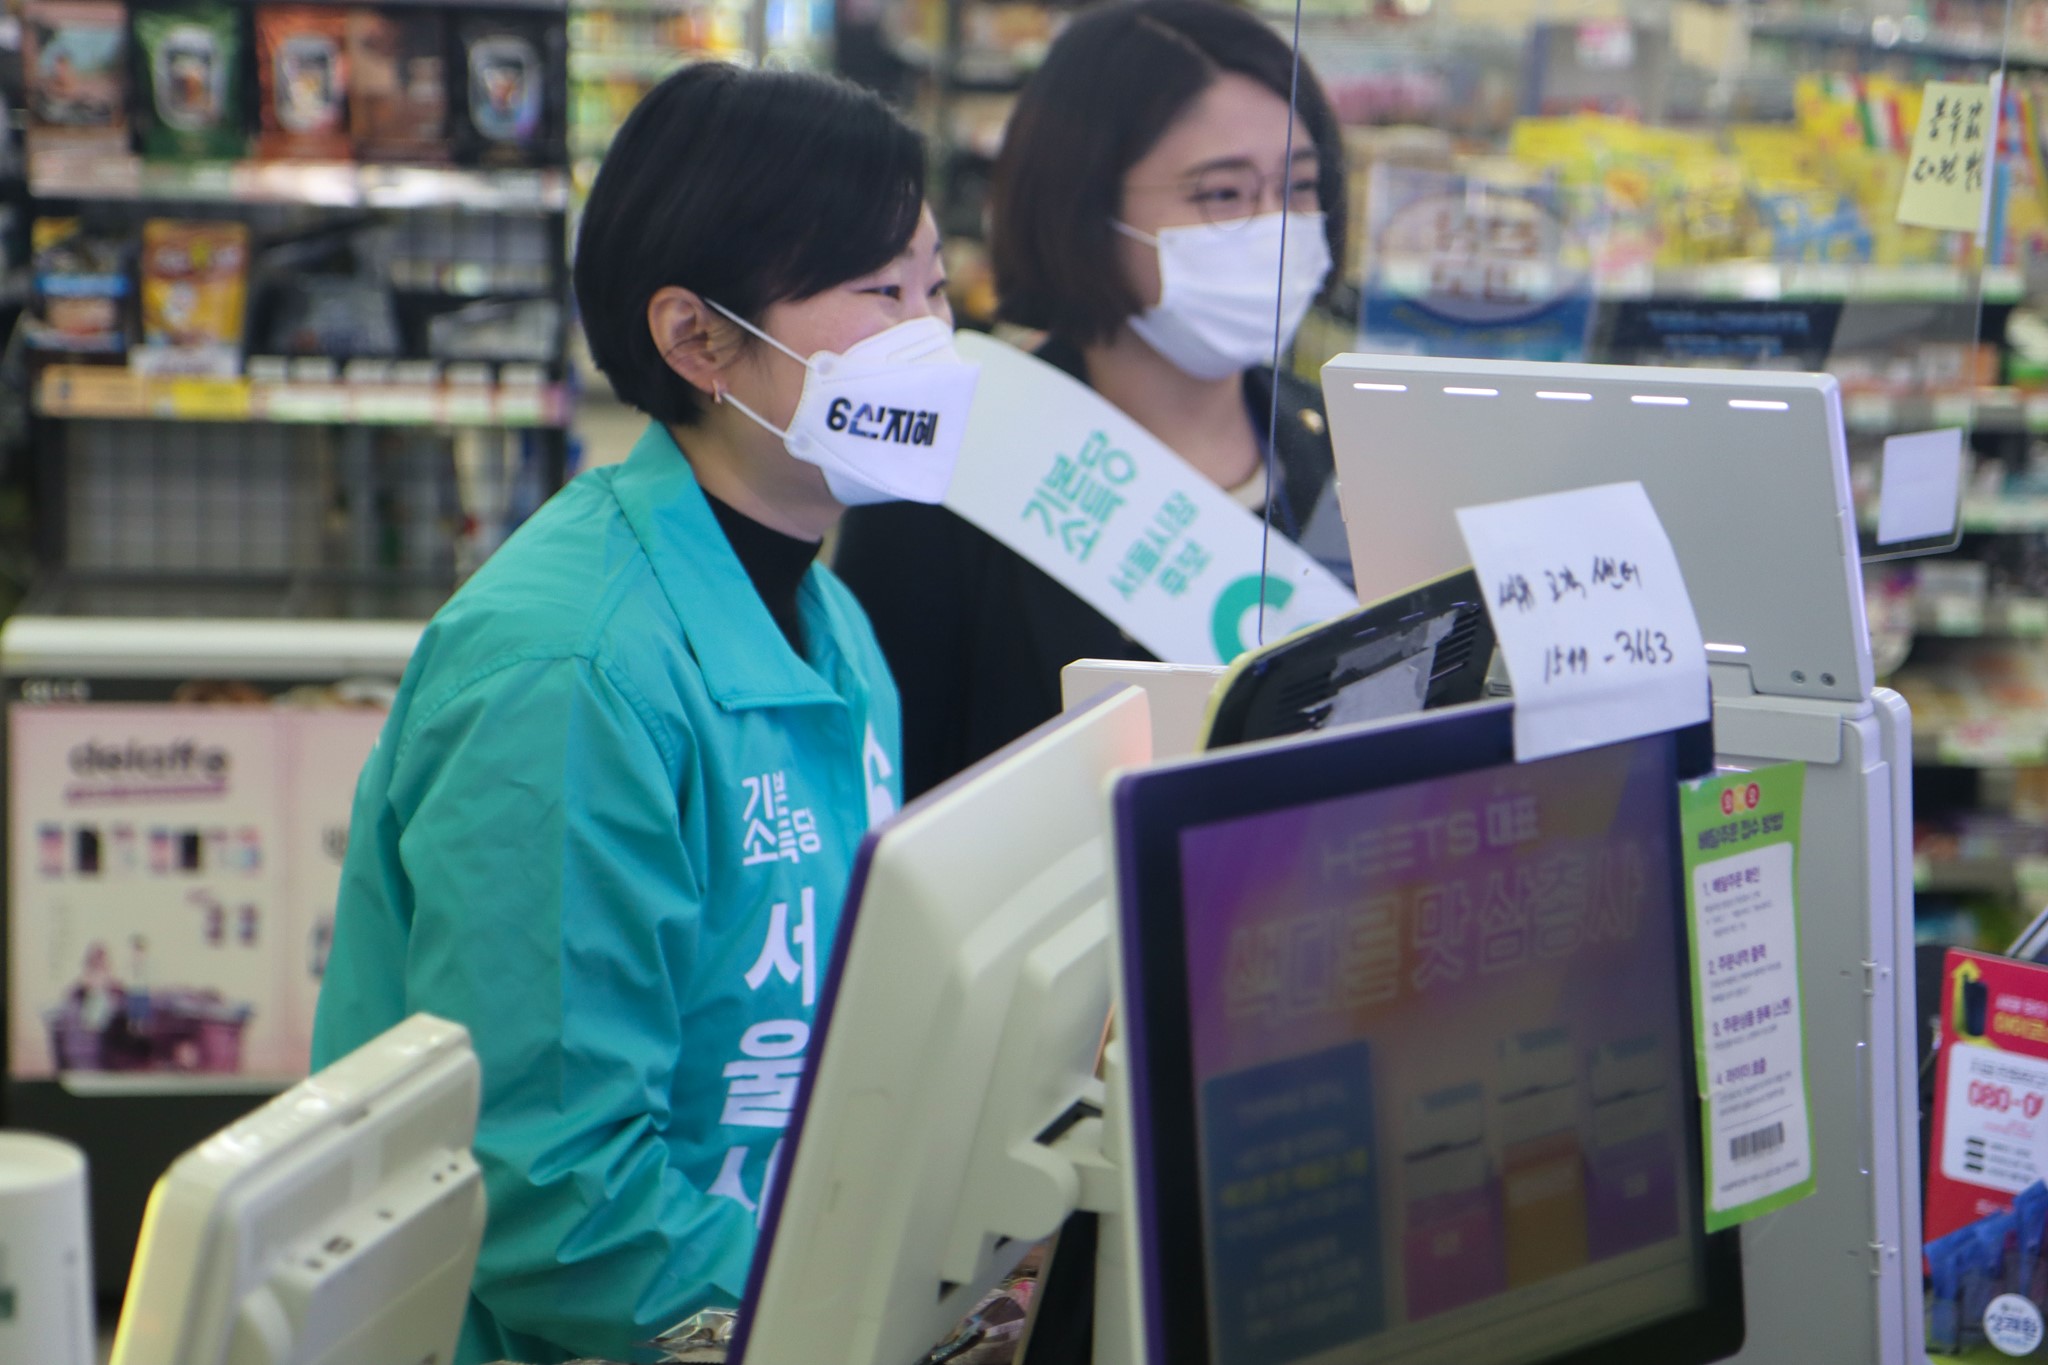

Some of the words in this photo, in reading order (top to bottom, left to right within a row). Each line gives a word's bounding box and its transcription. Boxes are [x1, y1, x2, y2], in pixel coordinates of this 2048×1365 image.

[1110, 491, 1198, 600] 서울시장
[1157, 540, 1213, 598] 후보
[1321, 811, 1479, 881] HEETS
